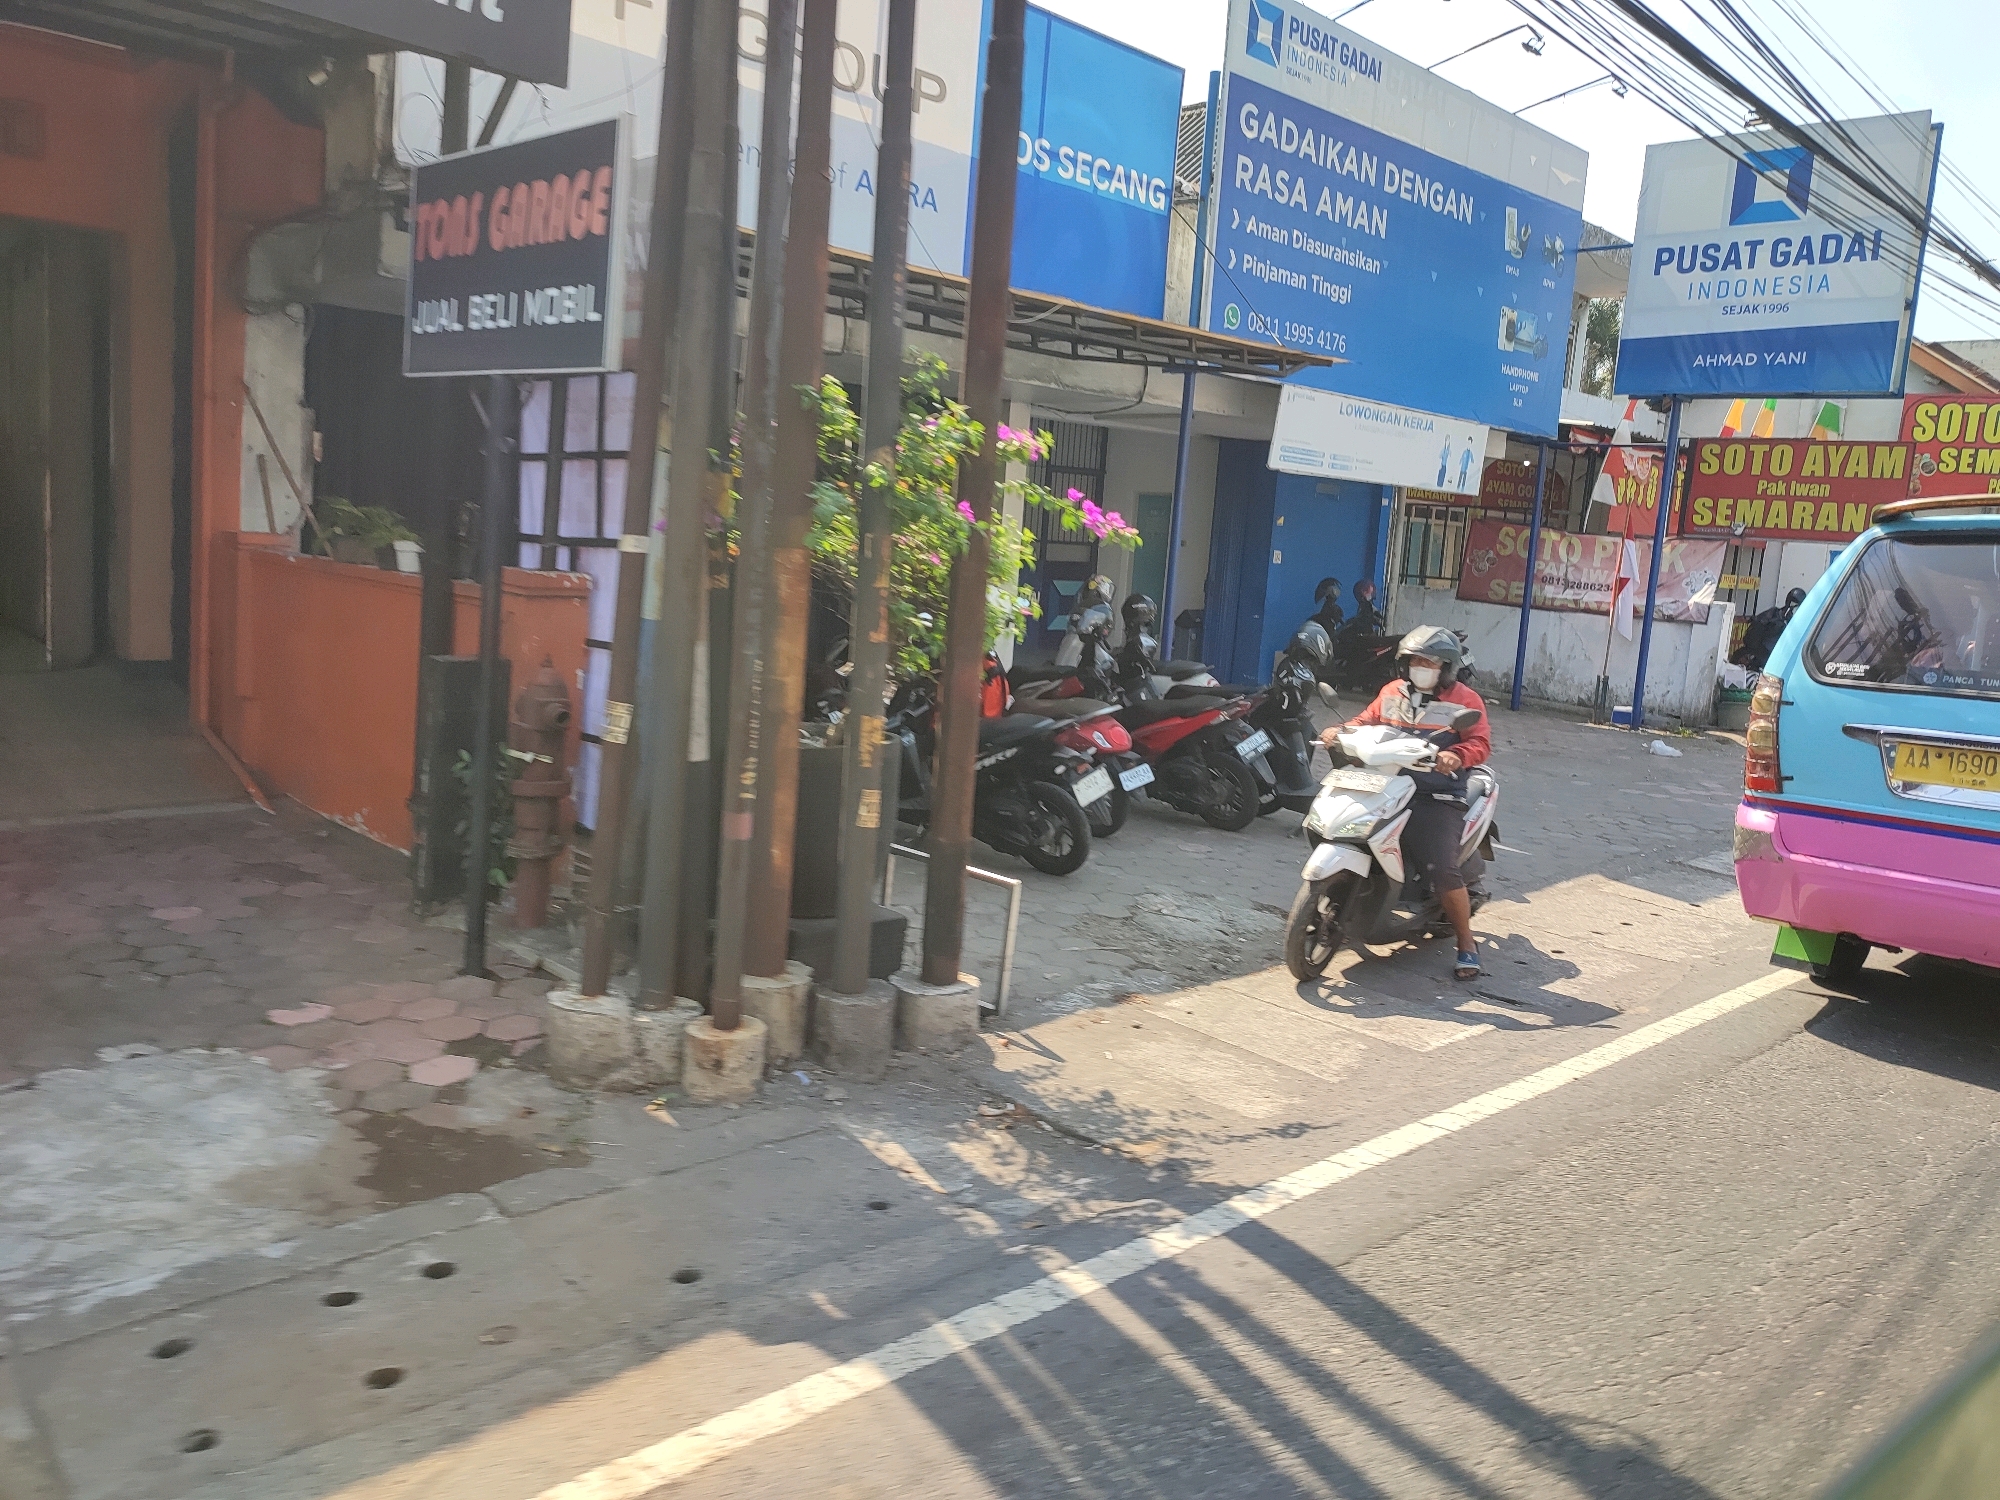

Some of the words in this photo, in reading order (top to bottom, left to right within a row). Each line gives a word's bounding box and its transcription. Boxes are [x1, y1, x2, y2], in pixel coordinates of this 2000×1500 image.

[738, 7, 947, 114] GOUP
[1287, 45, 1347, 87] INDONESIA
[1289, 15, 1338, 60] PUSAT
[1340, 42, 1383, 83] GADAI
[1057, 145, 1167, 211] SECANG
[1240, 102, 1378, 187] GADAIKAN
[1384, 161, 1474, 225] DENGAN
[488, 164, 614, 252] GARAGE
[855, 169, 938, 213] ARA
[1235, 154, 1307, 213] RASA
[1316, 186, 1388, 239] AMAN
[1246, 215, 1289, 245] Aman
[1292, 228, 1381, 275] Diasuransikan
[1653, 239, 1764, 275] PUSAT
[1769, 229, 1882, 267] GADAI
[1242, 253, 1307, 290] Pinjaman
[1312, 274, 1352, 304] Tinggi
[1688, 273, 1831, 300] INDONESIA
[411, 297, 464, 334] JUAL
[467, 291, 519, 330] BELI
[522, 283, 602, 326] MOBIL
[1721, 303, 1760, 316] SEJAK
[1762, 302, 1790, 315] 1996
[1248, 311, 1280, 337] 0811
[1283, 321, 1314, 345] 1995
[1317, 332, 1347, 353] 4176
[1501, 363, 1539, 382] HANDPHONE
[1693, 352, 1758, 368] AHMAD
[1763, 351, 1807, 366] YANI
[1509, 382, 1529, 394] LAPTOP
[1339, 401, 1401, 427] LOWONGAN
[1403, 416, 1435, 433] KERJA
[1496, 460, 1526, 477] SOTO
[1699, 443, 1794, 477] SOTO
[1801, 444, 1907, 480] AYAM
[1485, 479, 1515, 496] AYAM
[1756, 479, 1787, 496] Pak
[1789, 481, 1831, 497] Iwan
[1496, 526, 1582, 566] SOTO
[1535, 561, 1575, 581] PAK
[1942, 675, 1974, 685] PANCA
[1904, 747, 1931, 769] AA
[1948, 751, 1998, 777] 1690
